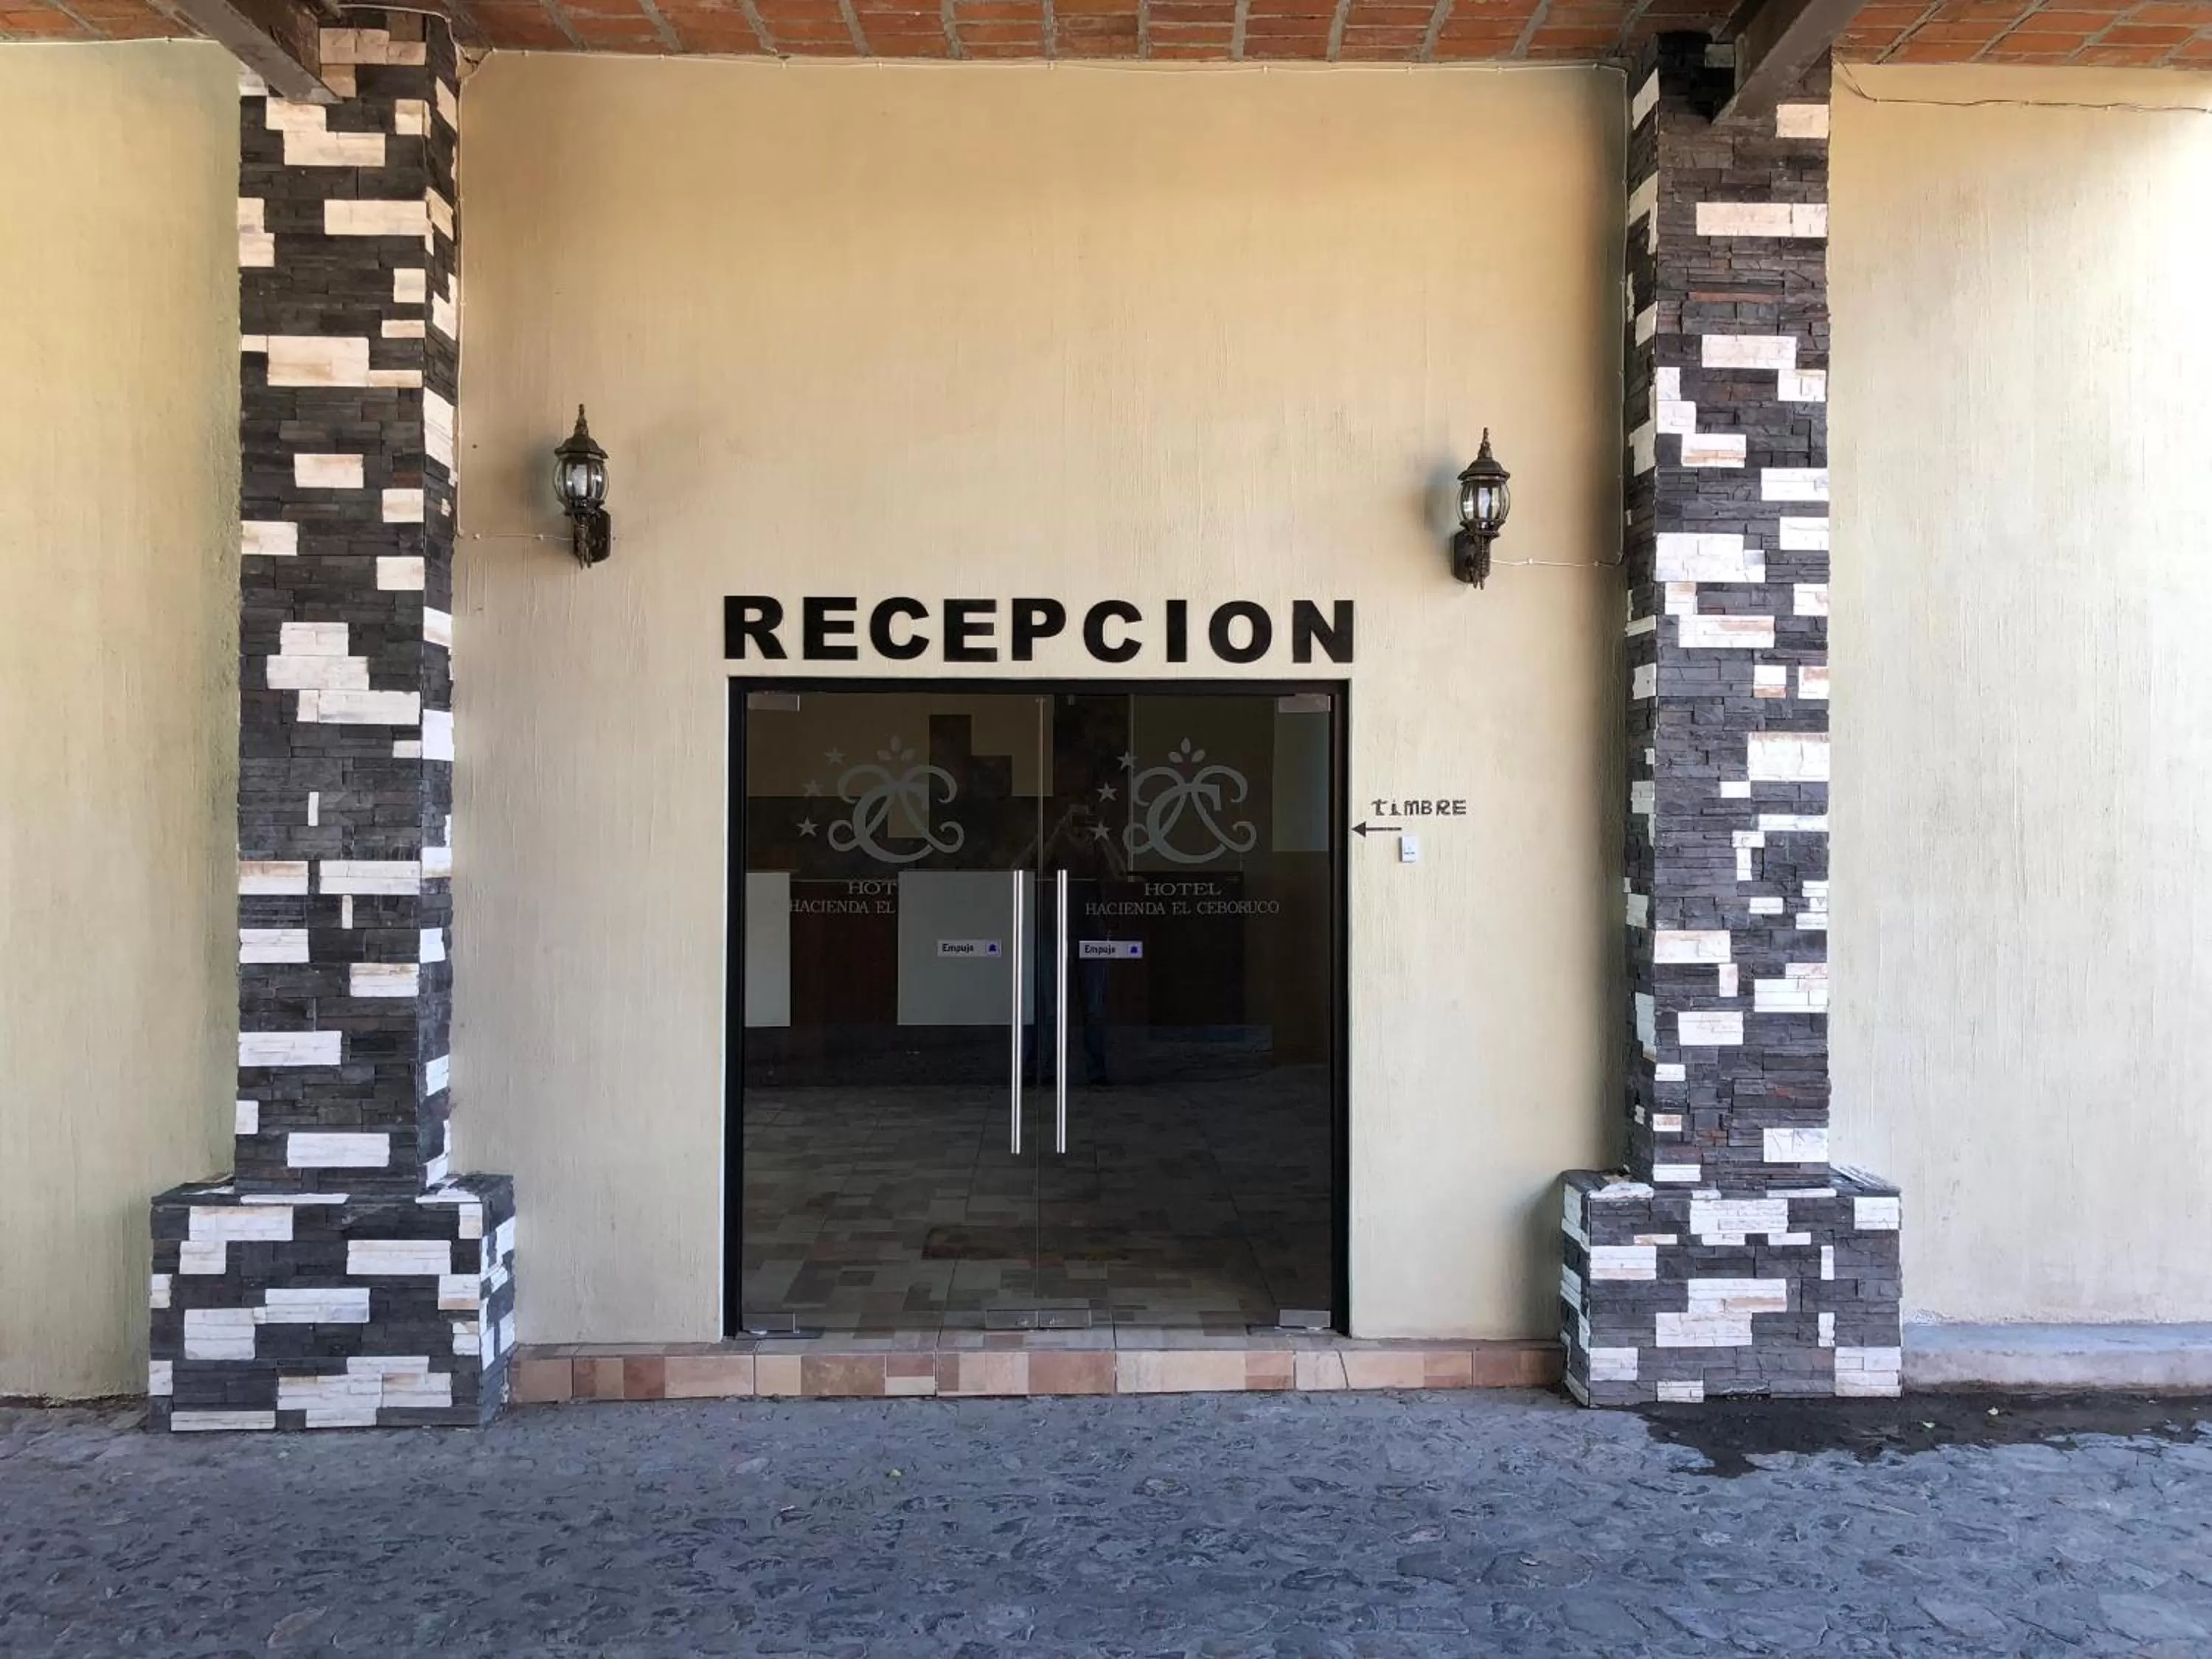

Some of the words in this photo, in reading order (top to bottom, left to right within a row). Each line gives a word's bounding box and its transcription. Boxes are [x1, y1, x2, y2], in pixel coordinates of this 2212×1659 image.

[723, 596, 1354, 663] RECEPCION
[849, 880, 897, 894] HOT
[1144, 883, 1222, 896] HOTEL
[877, 900, 896, 914] EL
[1085, 902, 1166, 915] HACIENDA
[1172, 902, 1192, 915] EL
[1197, 900, 1279, 914] CEBORUCO
